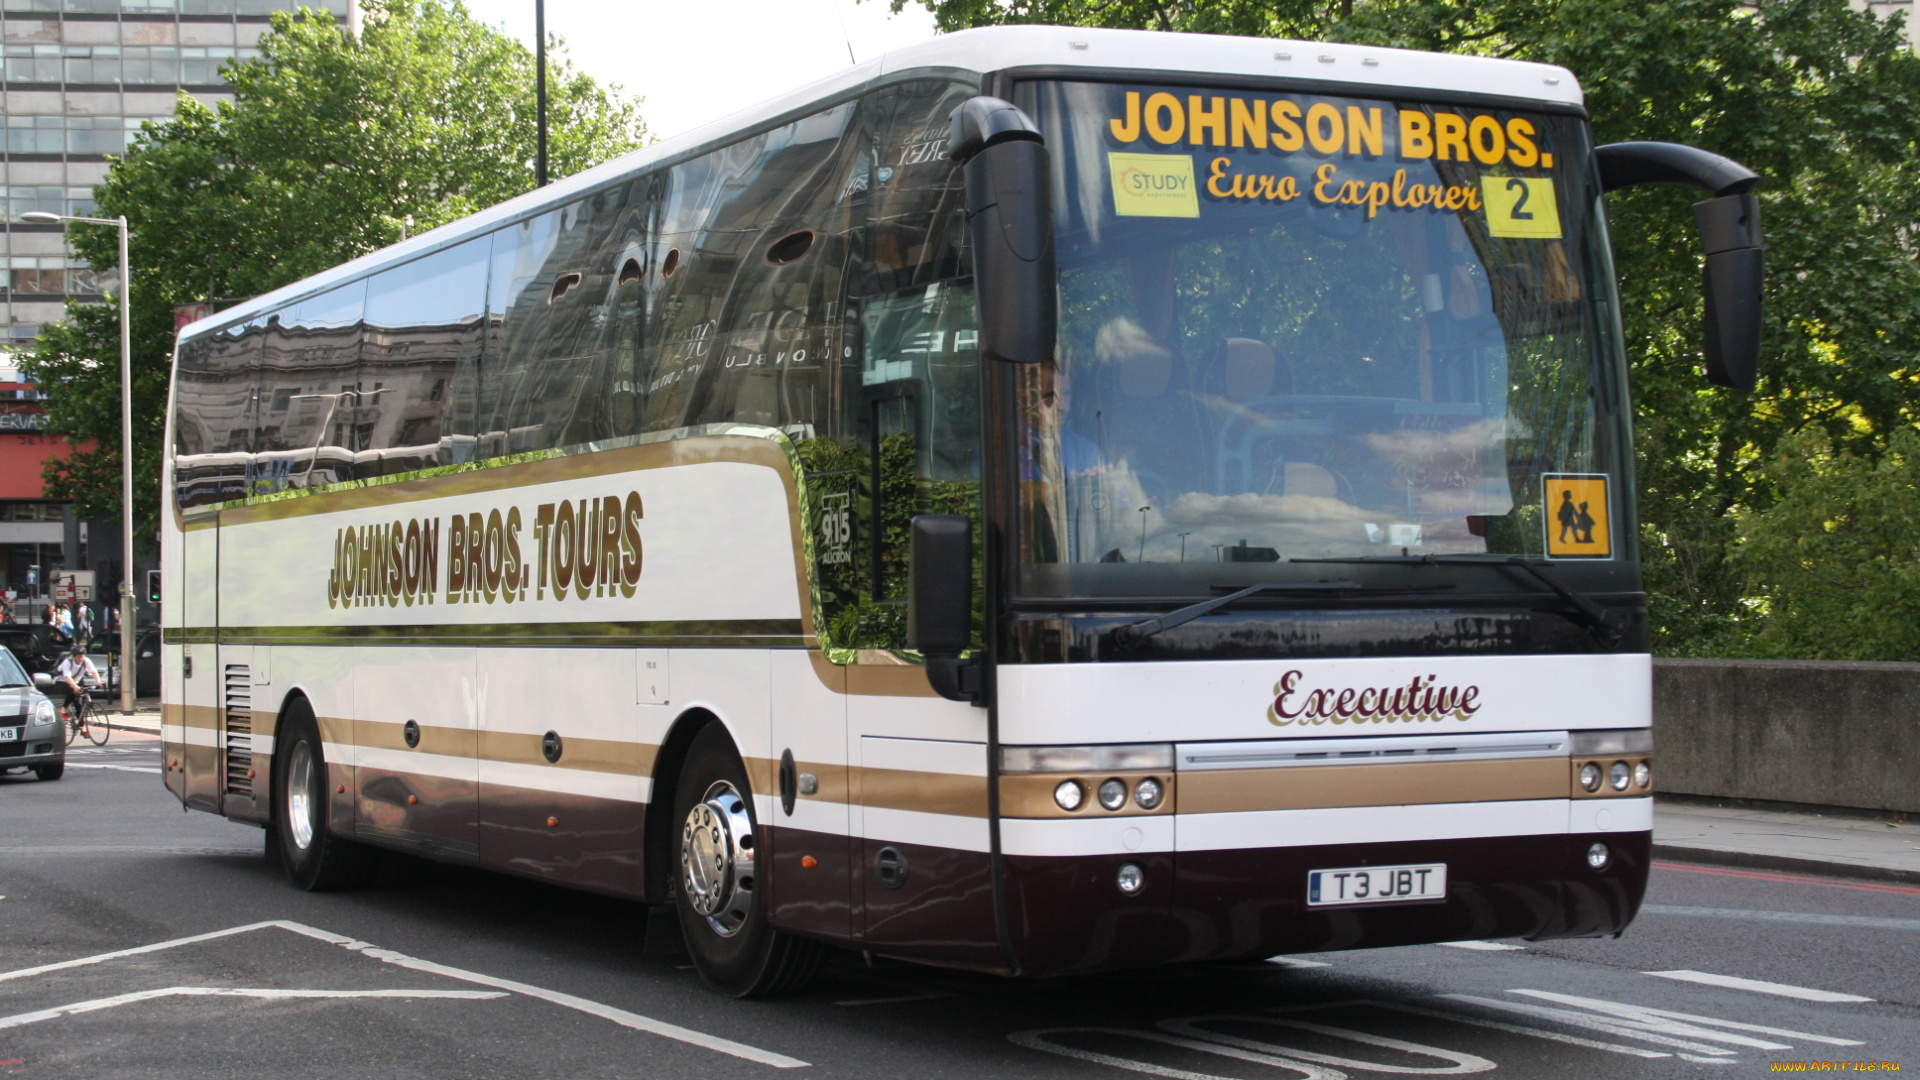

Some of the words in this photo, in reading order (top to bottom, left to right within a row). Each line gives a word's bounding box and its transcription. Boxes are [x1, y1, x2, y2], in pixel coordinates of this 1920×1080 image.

[1109, 91, 1384, 156] JOHNSON
[1399, 108, 1554, 168] BROS.
[1132, 173, 1188, 190] STUDY
[1206, 157, 1301, 201] Euro
[1313, 163, 1482, 218] Explorer
[1507, 178, 1534, 221] 2
[328, 517, 440, 609] JOHNSON
[446, 506, 530, 605] BROS.
[534, 490, 644, 601] TOURS
[822, 512, 851, 545] 915
[1267, 669, 1482, 727] Executive
[0, 729, 14, 739] KB
[1333, 872, 1370, 899] T3
[1379, 869, 1432, 897] JBT
